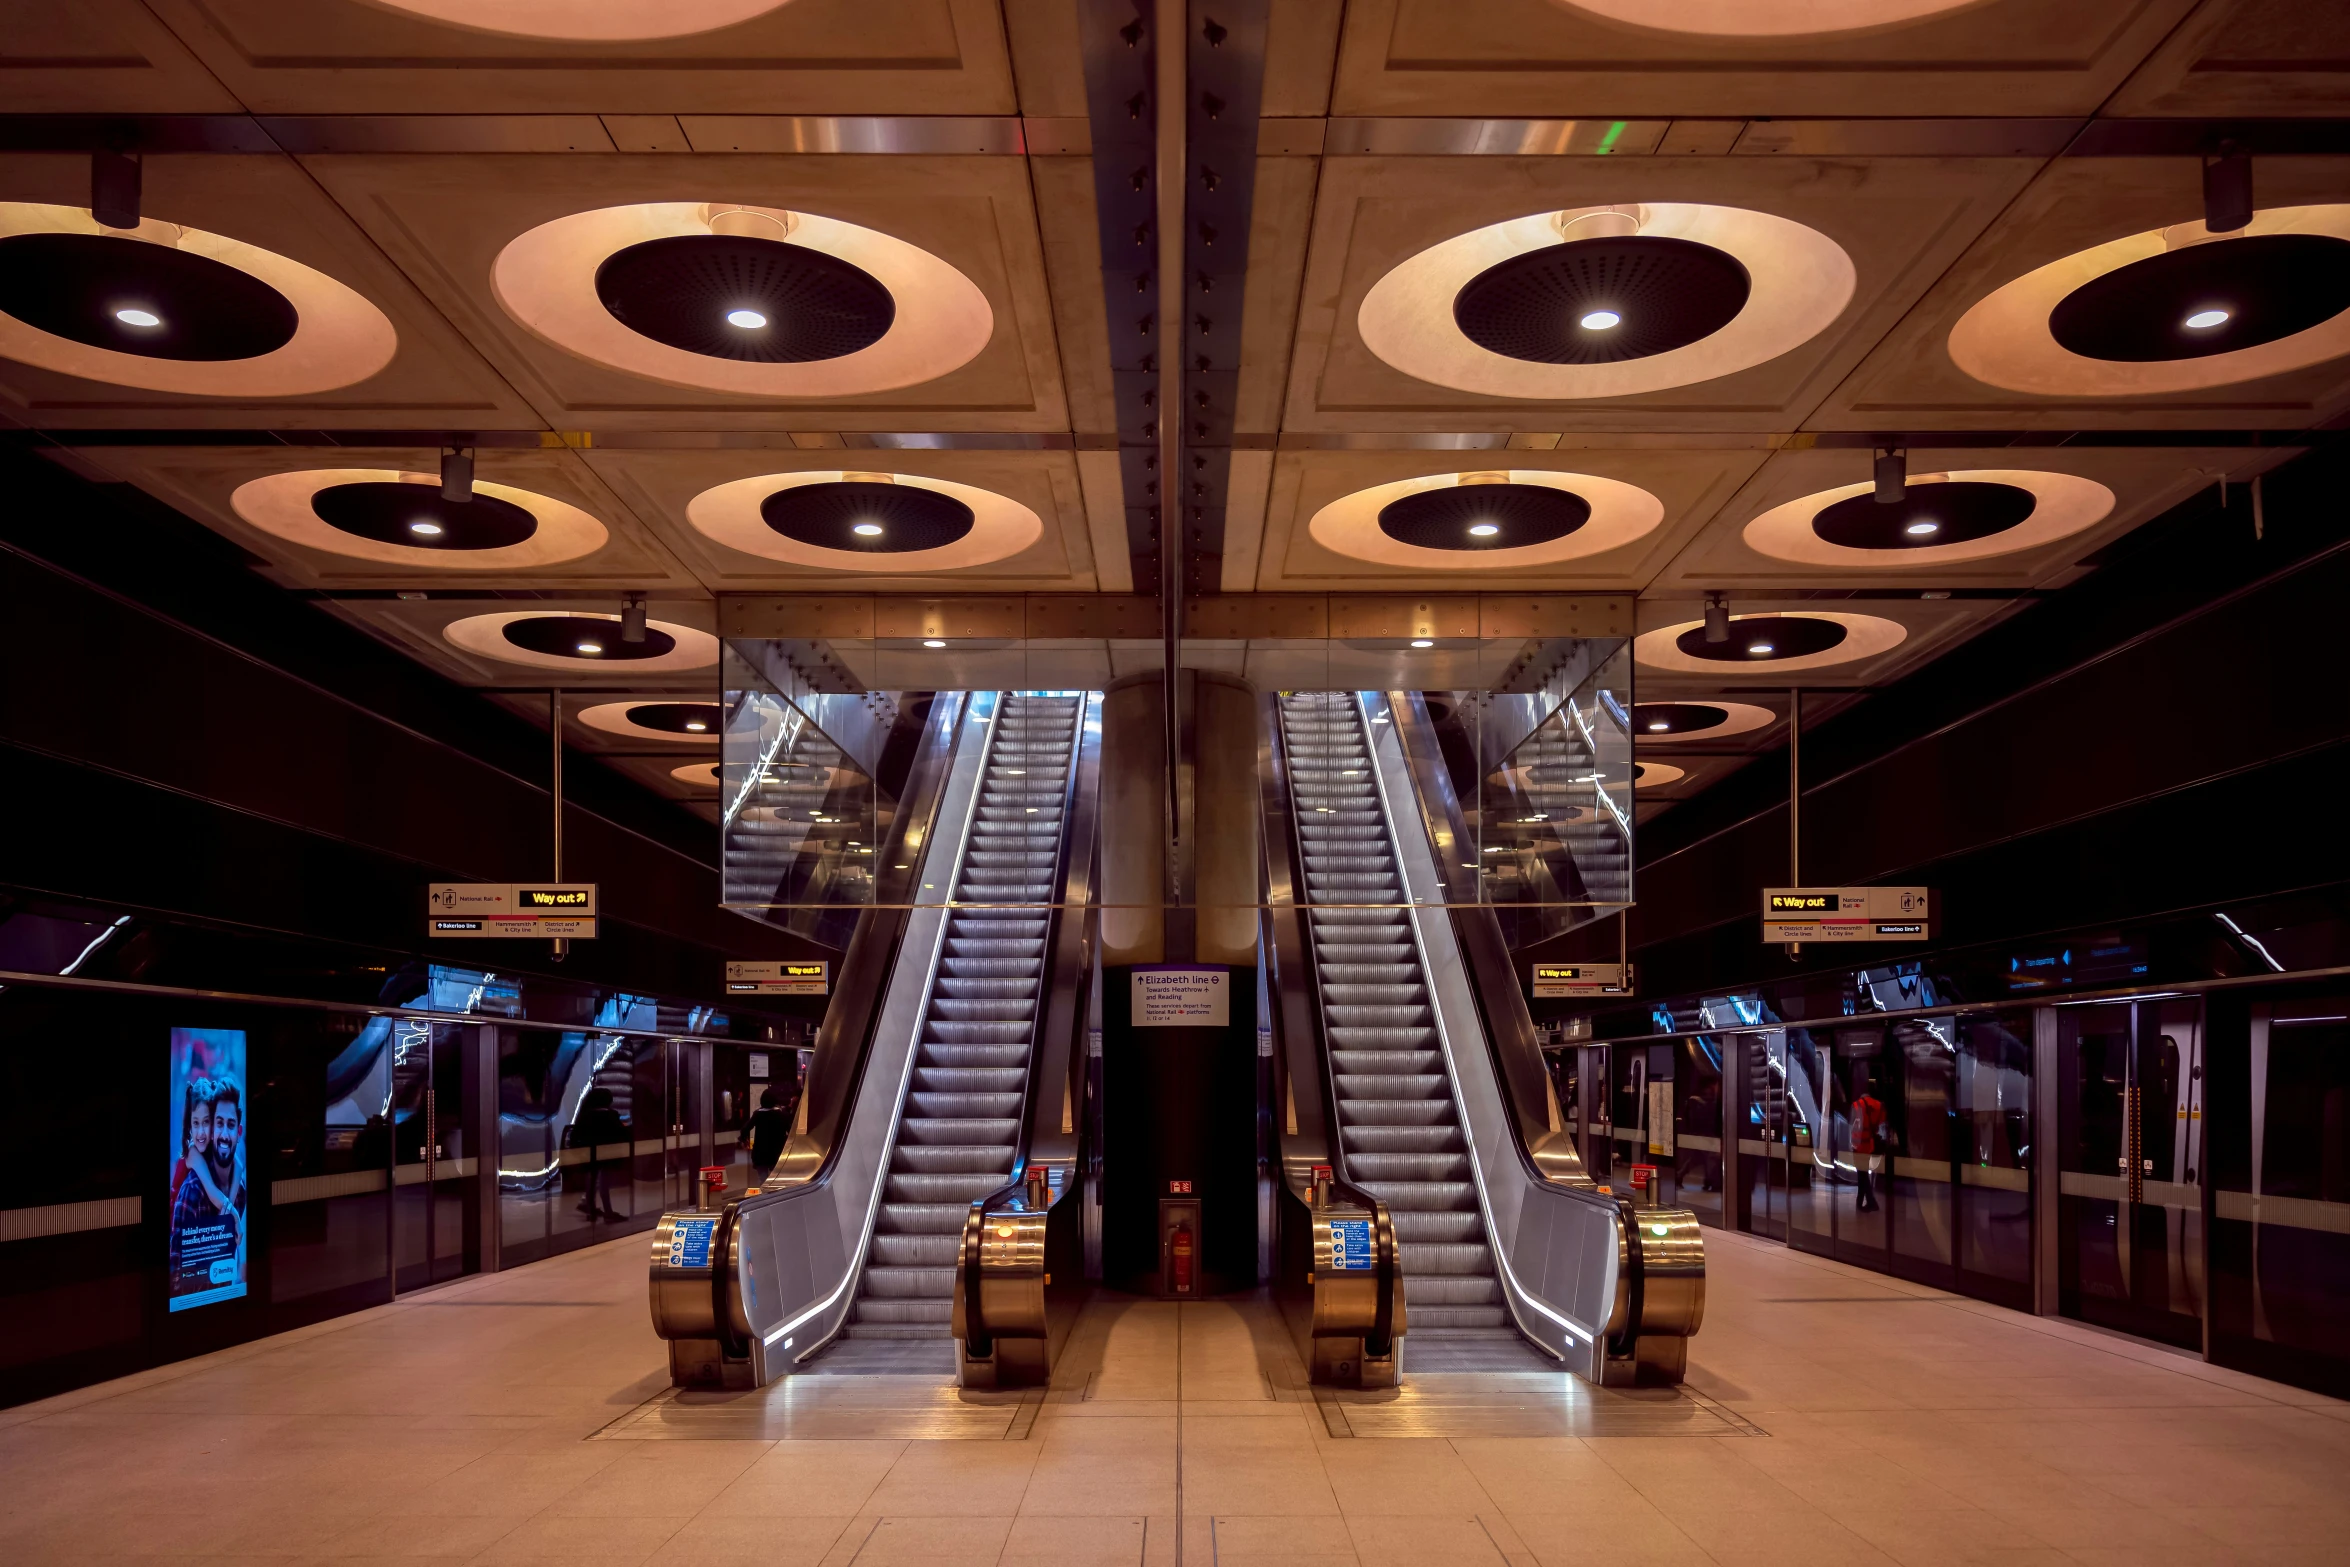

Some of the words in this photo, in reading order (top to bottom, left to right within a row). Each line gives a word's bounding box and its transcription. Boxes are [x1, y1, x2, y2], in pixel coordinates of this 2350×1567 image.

[532, 892, 555, 906] Way
[556, 893, 576, 904] out
[1782, 897, 1805, 909] Way
[1807, 897, 1825, 907] out
[509, 926, 521, 934] City
[1832, 930, 1843, 938] City
[787, 966, 802, 976] Way
[802, 967, 814, 975] out
[1546, 969, 1559, 978] Way
[1560, 969, 1572, 977] out
[1146, 975, 1189, 984] Elizabeth
[1192, 975, 1209, 984] line
[182, 1226, 198, 1237] Behind
[199, 1226, 210, 1235] every
[211, 1224, 225, 1232] money
[182, 1235, 200, 1246] transfer,
[201, 1233, 215, 1243] there's
[1340, 1362, 1349, 1376] 9
